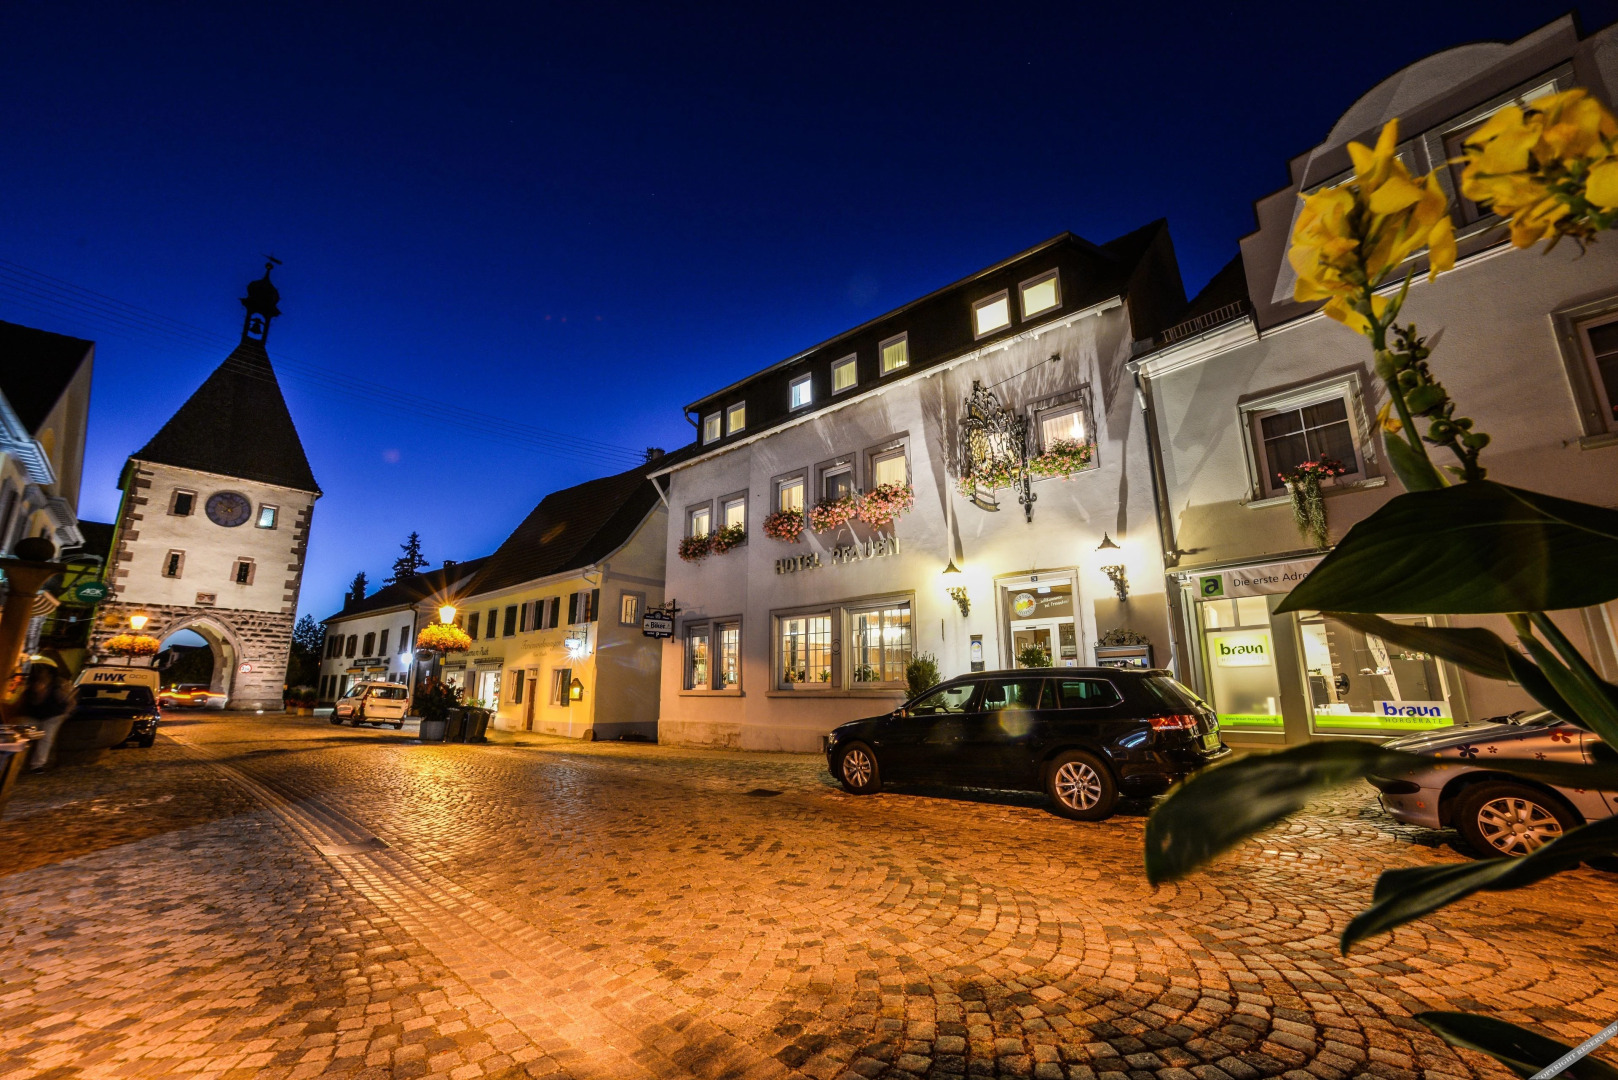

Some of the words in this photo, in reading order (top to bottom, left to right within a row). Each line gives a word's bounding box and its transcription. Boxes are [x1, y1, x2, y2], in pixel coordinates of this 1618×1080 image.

[775, 552, 823, 575] HOTEL
[831, 537, 900, 565] PFAUEN
[1233, 578, 1250, 587] Die
[1253, 575, 1279, 585] erste
[79, 587, 104, 597] AOK
[1220, 643, 1264, 655] braun
[93, 672, 127, 683] HWK
[1382, 702, 1442, 717] braun
